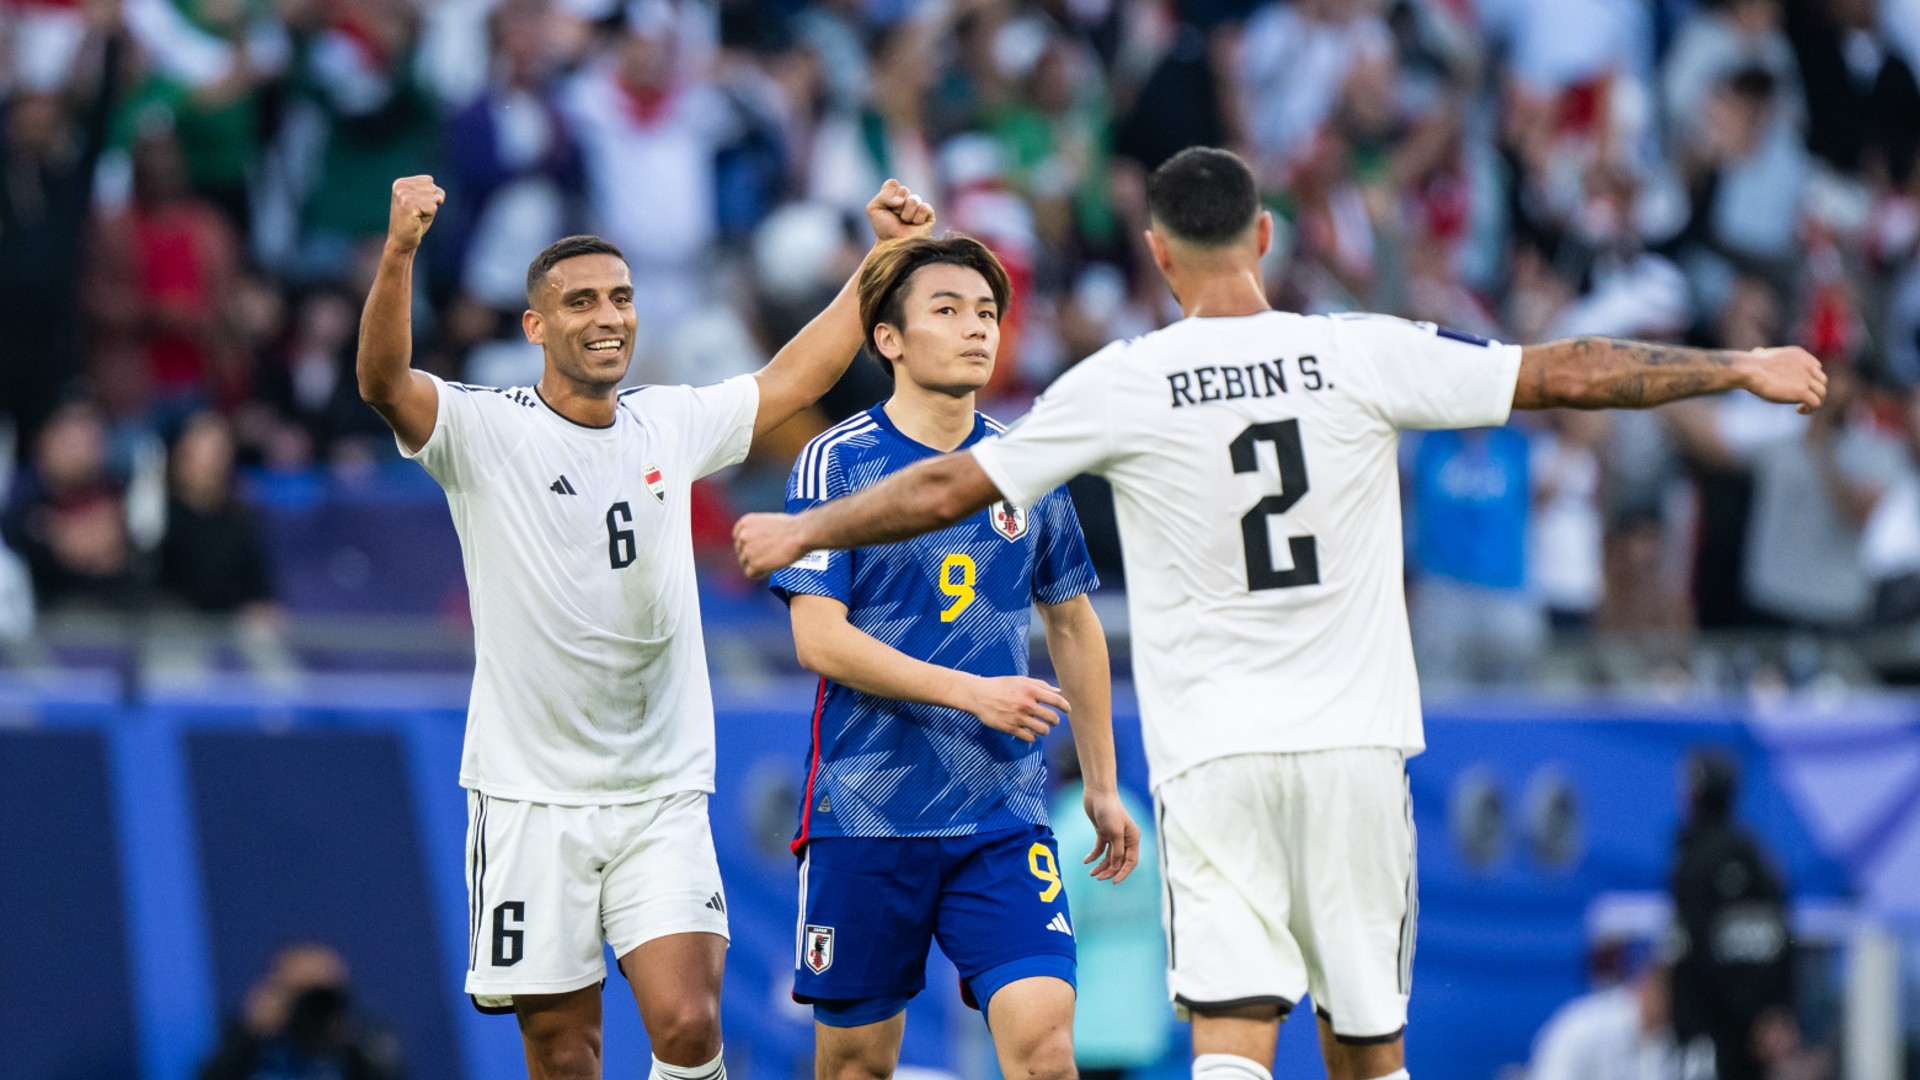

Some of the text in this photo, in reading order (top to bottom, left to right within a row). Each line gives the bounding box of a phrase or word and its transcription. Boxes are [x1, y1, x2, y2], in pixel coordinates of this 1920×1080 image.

[1166, 355, 1334, 408] REBIN S.
[606, 501, 637, 569] 6
[1002, 521, 1019, 531] JFA
[1229, 418, 1321, 591] 2
[939, 553, 976, 622] 9
[1028, 842, 1062, 903] 9
[491, 901, 525, 967] 6
